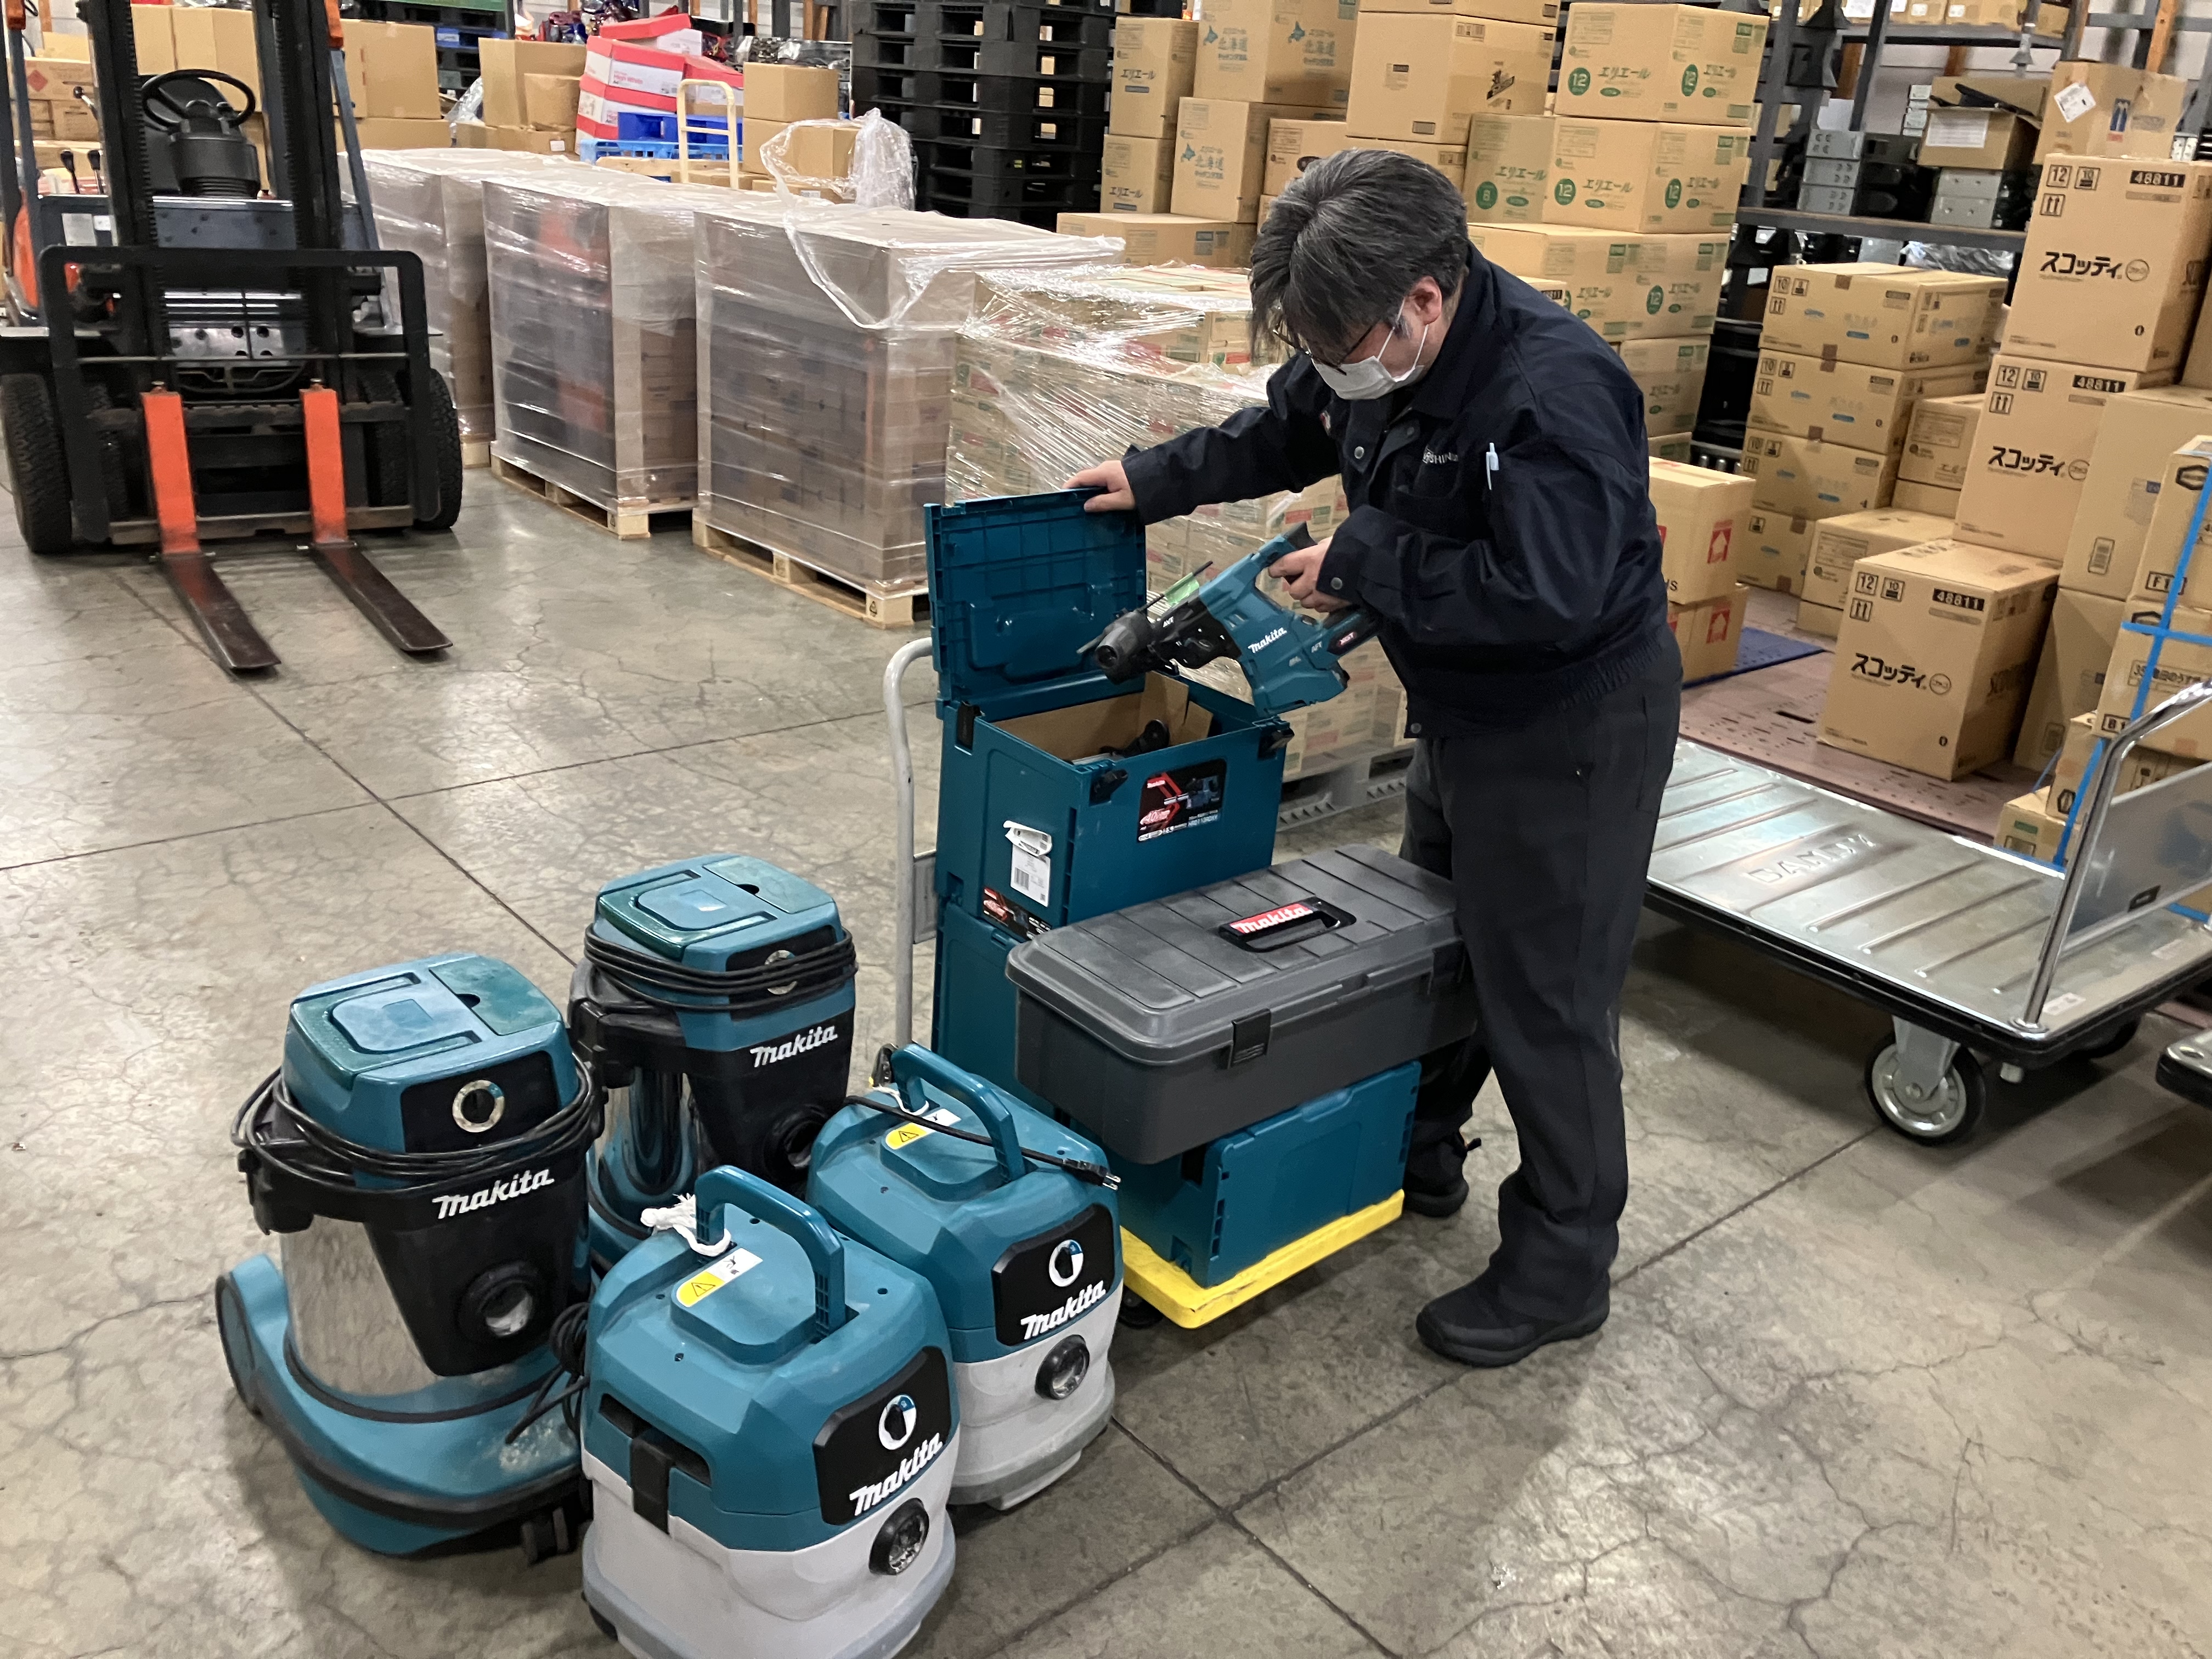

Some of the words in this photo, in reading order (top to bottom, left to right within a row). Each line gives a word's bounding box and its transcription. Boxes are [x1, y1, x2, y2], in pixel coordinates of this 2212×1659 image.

[1120, 69, 1155, 80] エリエール
[1573, 73, 1588, 87] 12
[1596, 67, 1651, 80] エリエール
[1685, 70, 1697, 86] 12
[1495, 166, 1547, 180] エリエール
[2053, 167, 2068, 182] 12
[2134, 171, 2179, 187] 48811
[1109, 187, 1143, 198] エリエール
[1558, 183, 1573, 197] 12
[1583, 179, 1634, 193] エリエール
[1668, 184, 1680, 199] 12
[2040, 251, 2123, 279] スコッティ
[1650, 292, 1661, 305] 12
[2002, 369, 2016, 383] 12
[2077, 376, 2120, 393] 48811
[1988, 445, 2066, 476] スコッティ
[1860, 574, 1875, 590] 12
[1889, 581, 1899, 591] 10
[1937, 591, 1978, 610] 48811
[1851, 652, 1927, 688] スコッティ
